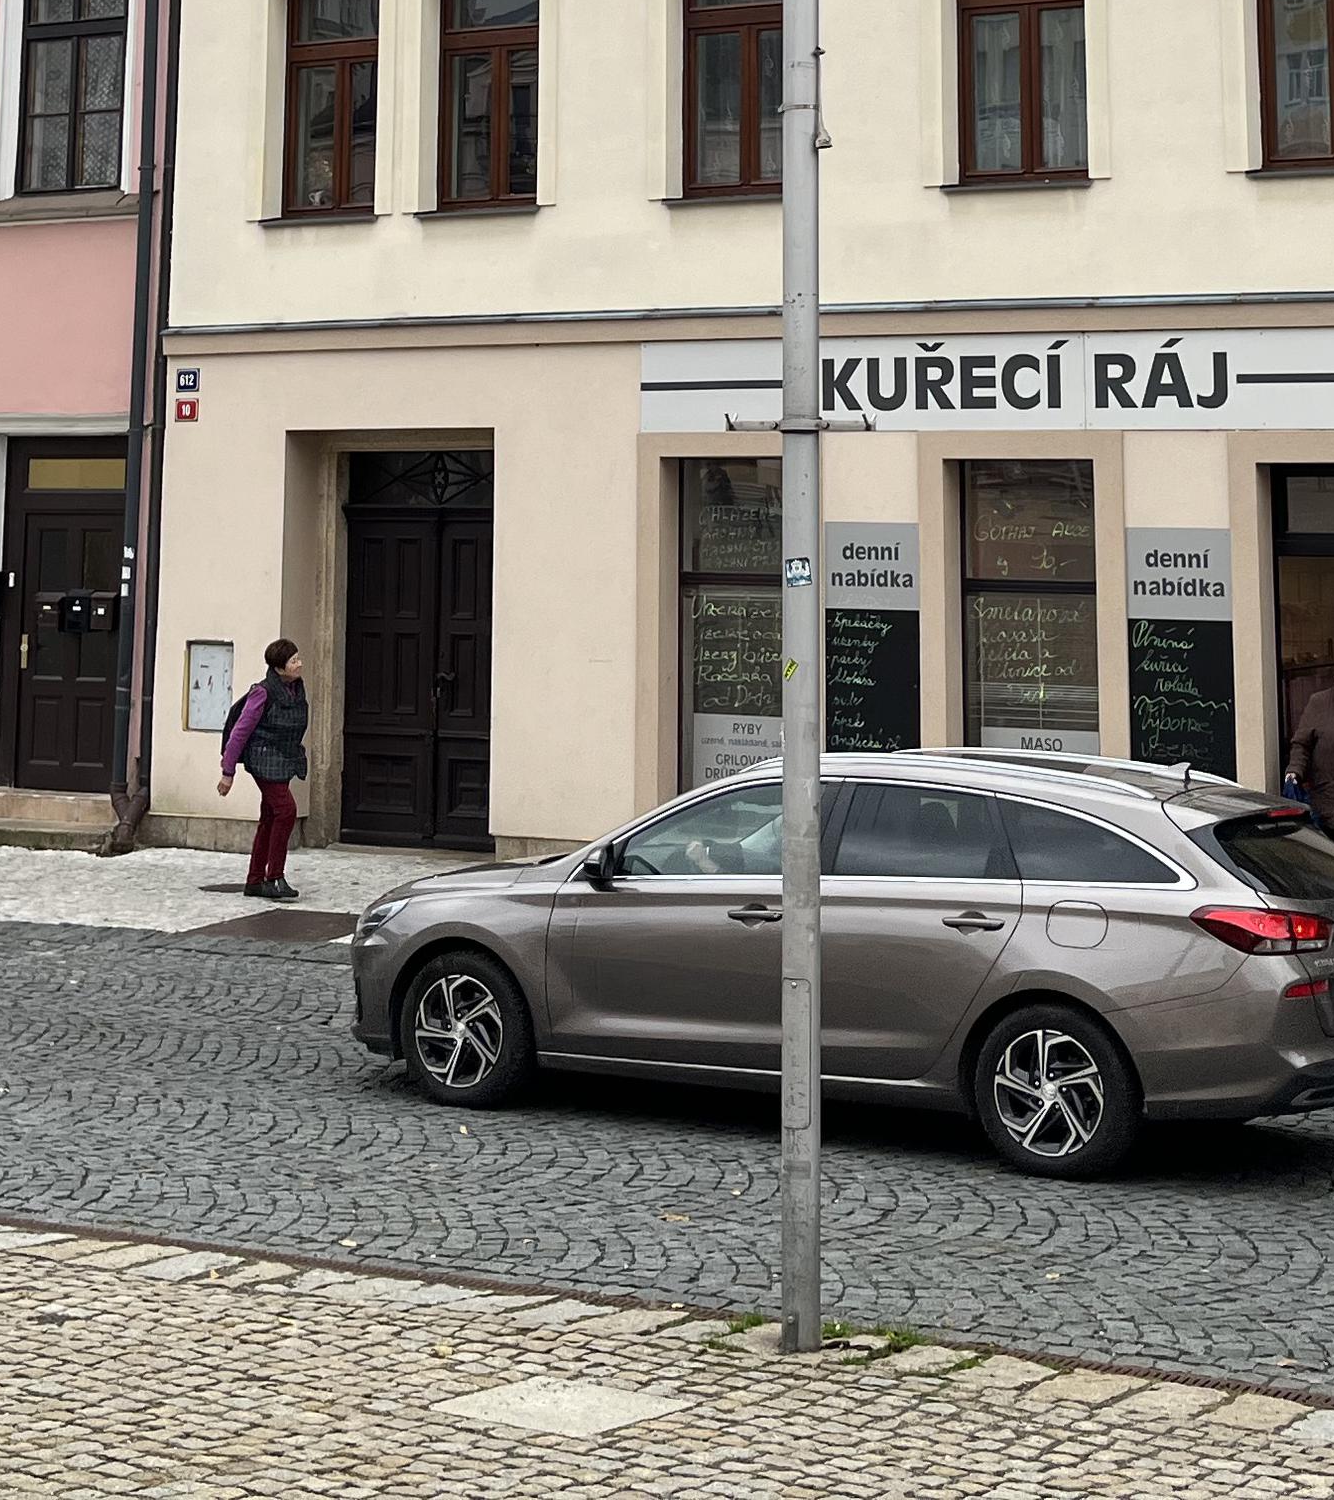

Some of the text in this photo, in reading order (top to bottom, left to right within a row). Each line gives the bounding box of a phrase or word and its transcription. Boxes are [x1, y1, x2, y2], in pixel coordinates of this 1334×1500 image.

[179, 374, 195, 387] 612
[821, 337, 1229, 412] KUŘECÍ RÁJ
[181, 404, 191, 416] 10
[842, 542, 901, 560] denní
[1145, 549, 1210, 568] denní
[831, 568, 914, 588] nabídka
[1133, 577, 1225, 597] nabídka
[732, 722, 762, 735] RYBY
[1021, 736, 1063, 752] MASO
